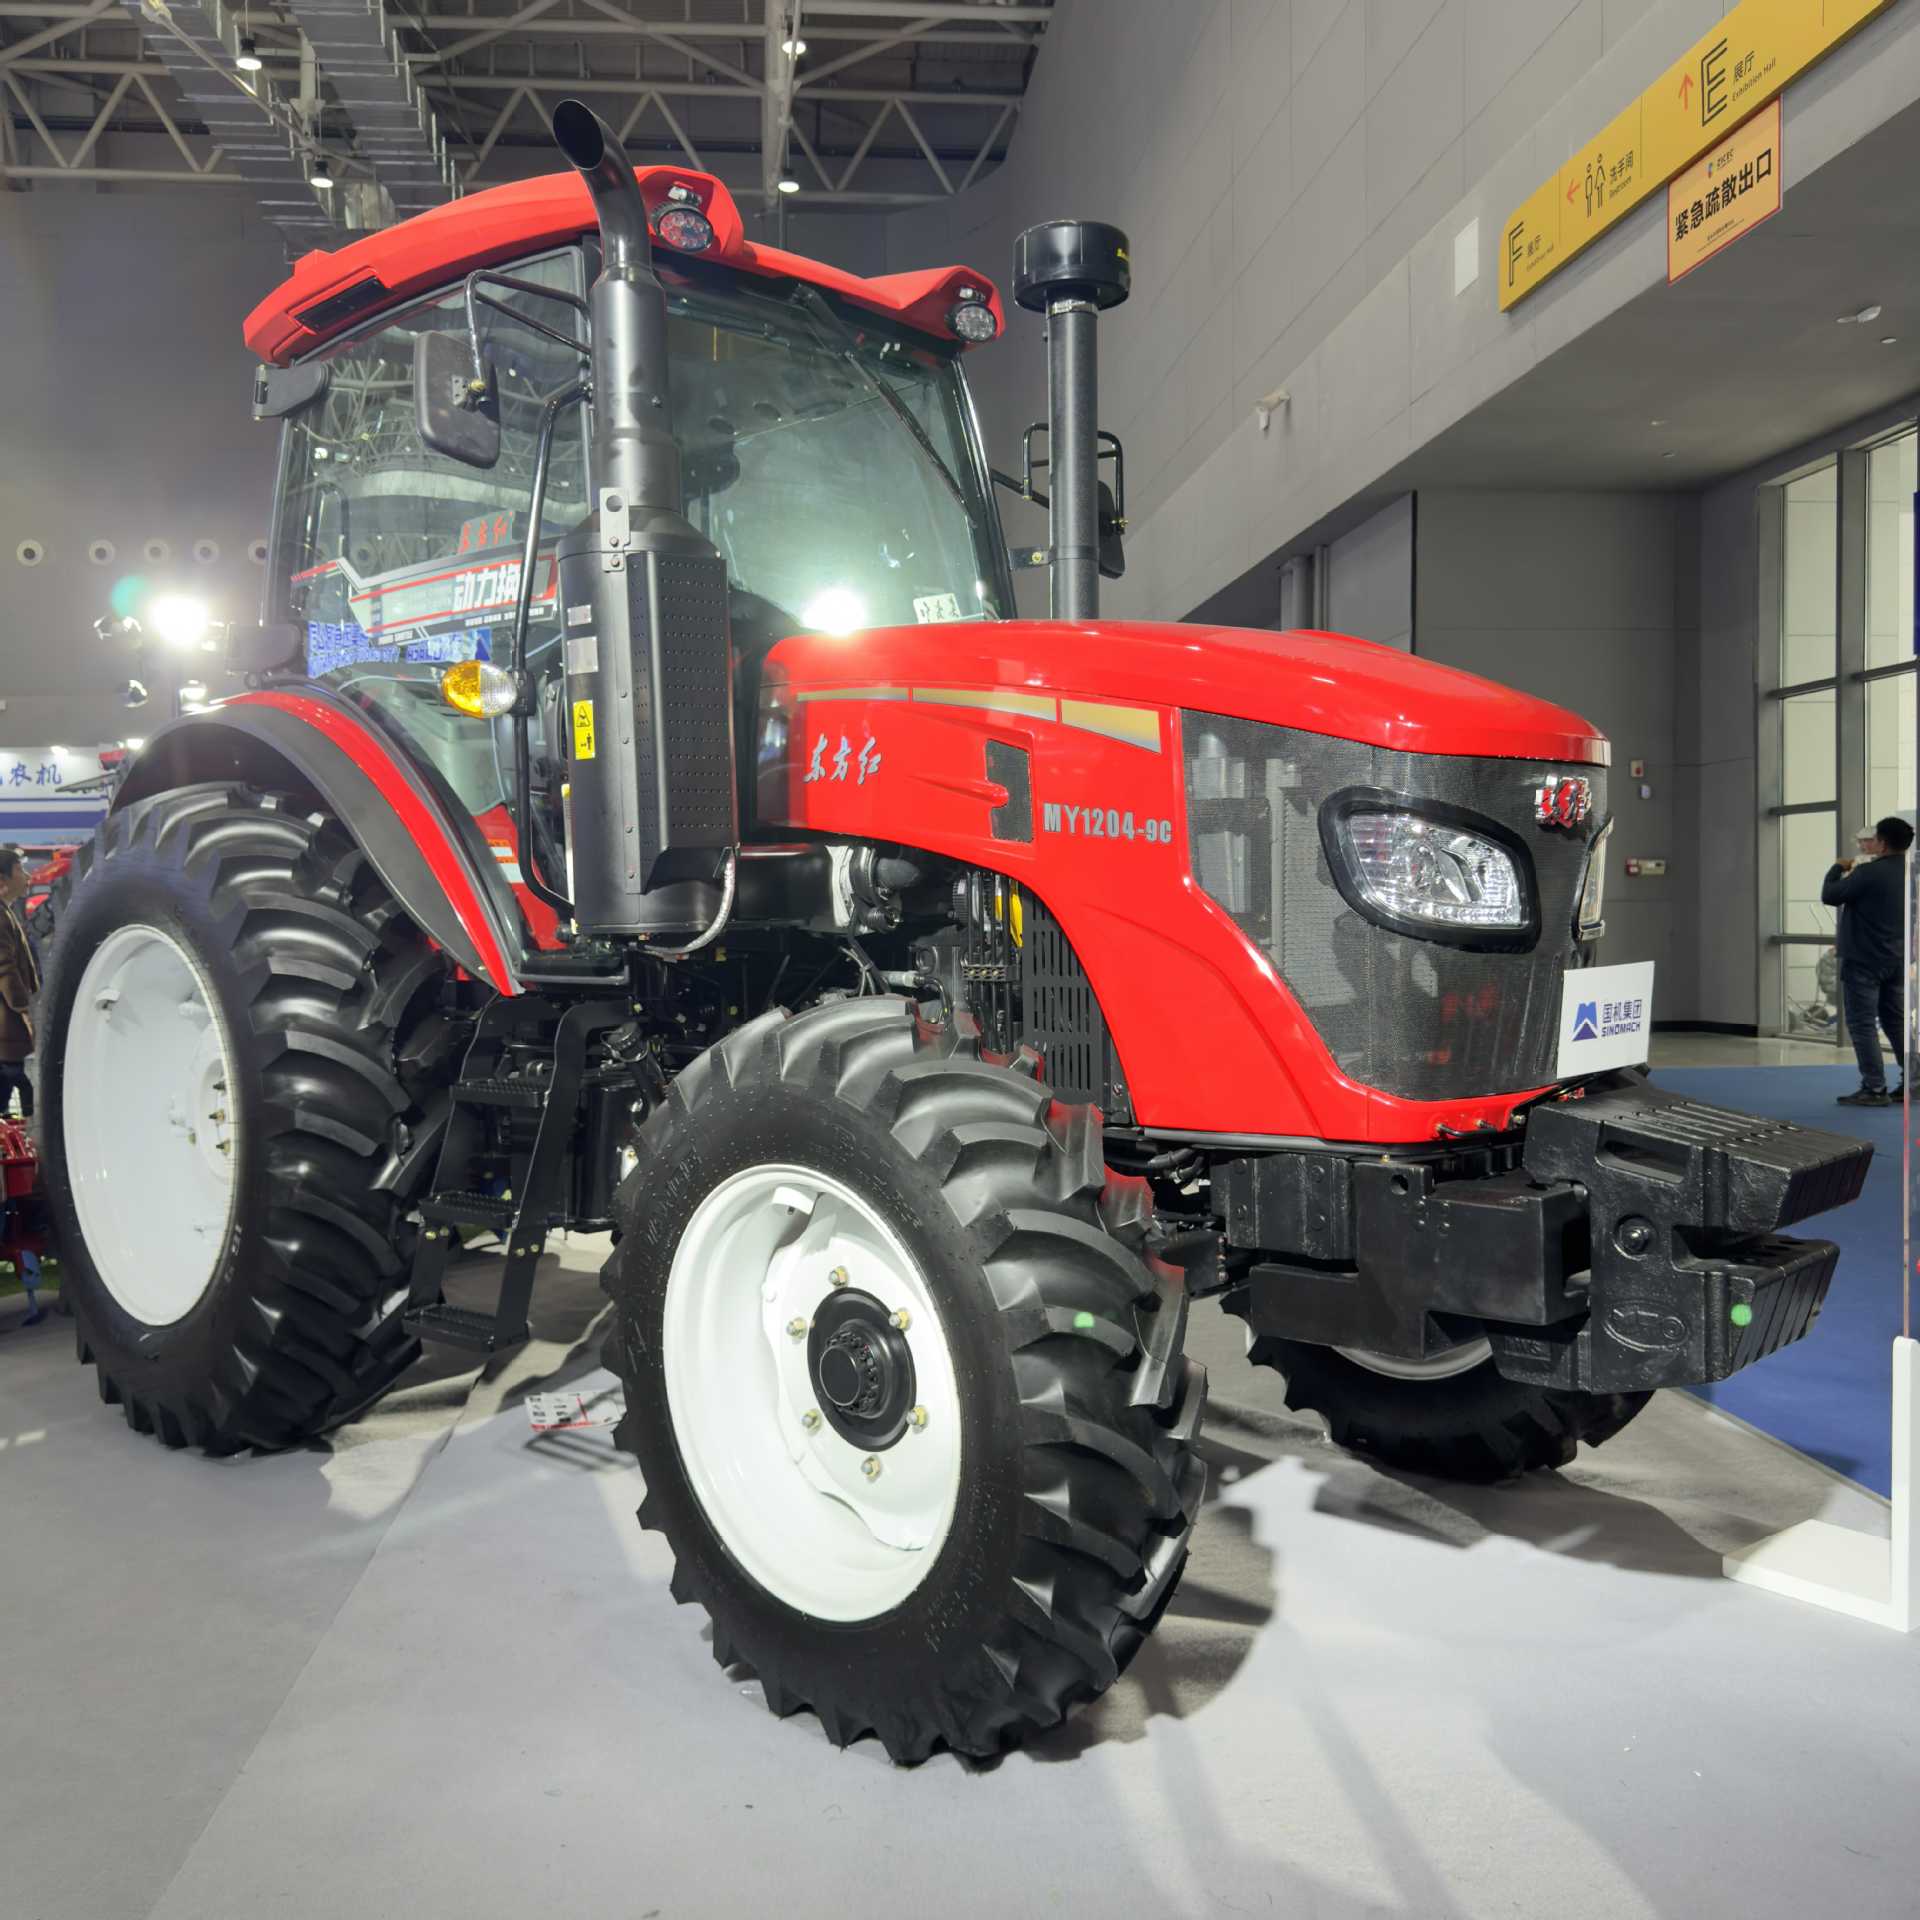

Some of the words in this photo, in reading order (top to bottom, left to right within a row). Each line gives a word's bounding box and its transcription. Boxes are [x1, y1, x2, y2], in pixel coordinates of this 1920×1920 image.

[1701, 38, 1727, 127] E
[1732, 71, 1763, 102] Exhibition
[1763, 57, 1776, 74] Hall
[1733, 50, 1754, 82] 展厅
[1609, 150, 1633, 183] 洗手间
[1675, 148, 1771, 242] 紧急疏散出口
[1508, 221, 1524, 288] F
[0, 761, 62, 786] 农机
[802, 732, 882, 785] 东方红
[1042, 801, 1172, 844] MY1204-9C
[1601, 1021, 1641, 1037] SINOMACH
[1602, 999, 1642, 1024] 国机集团
